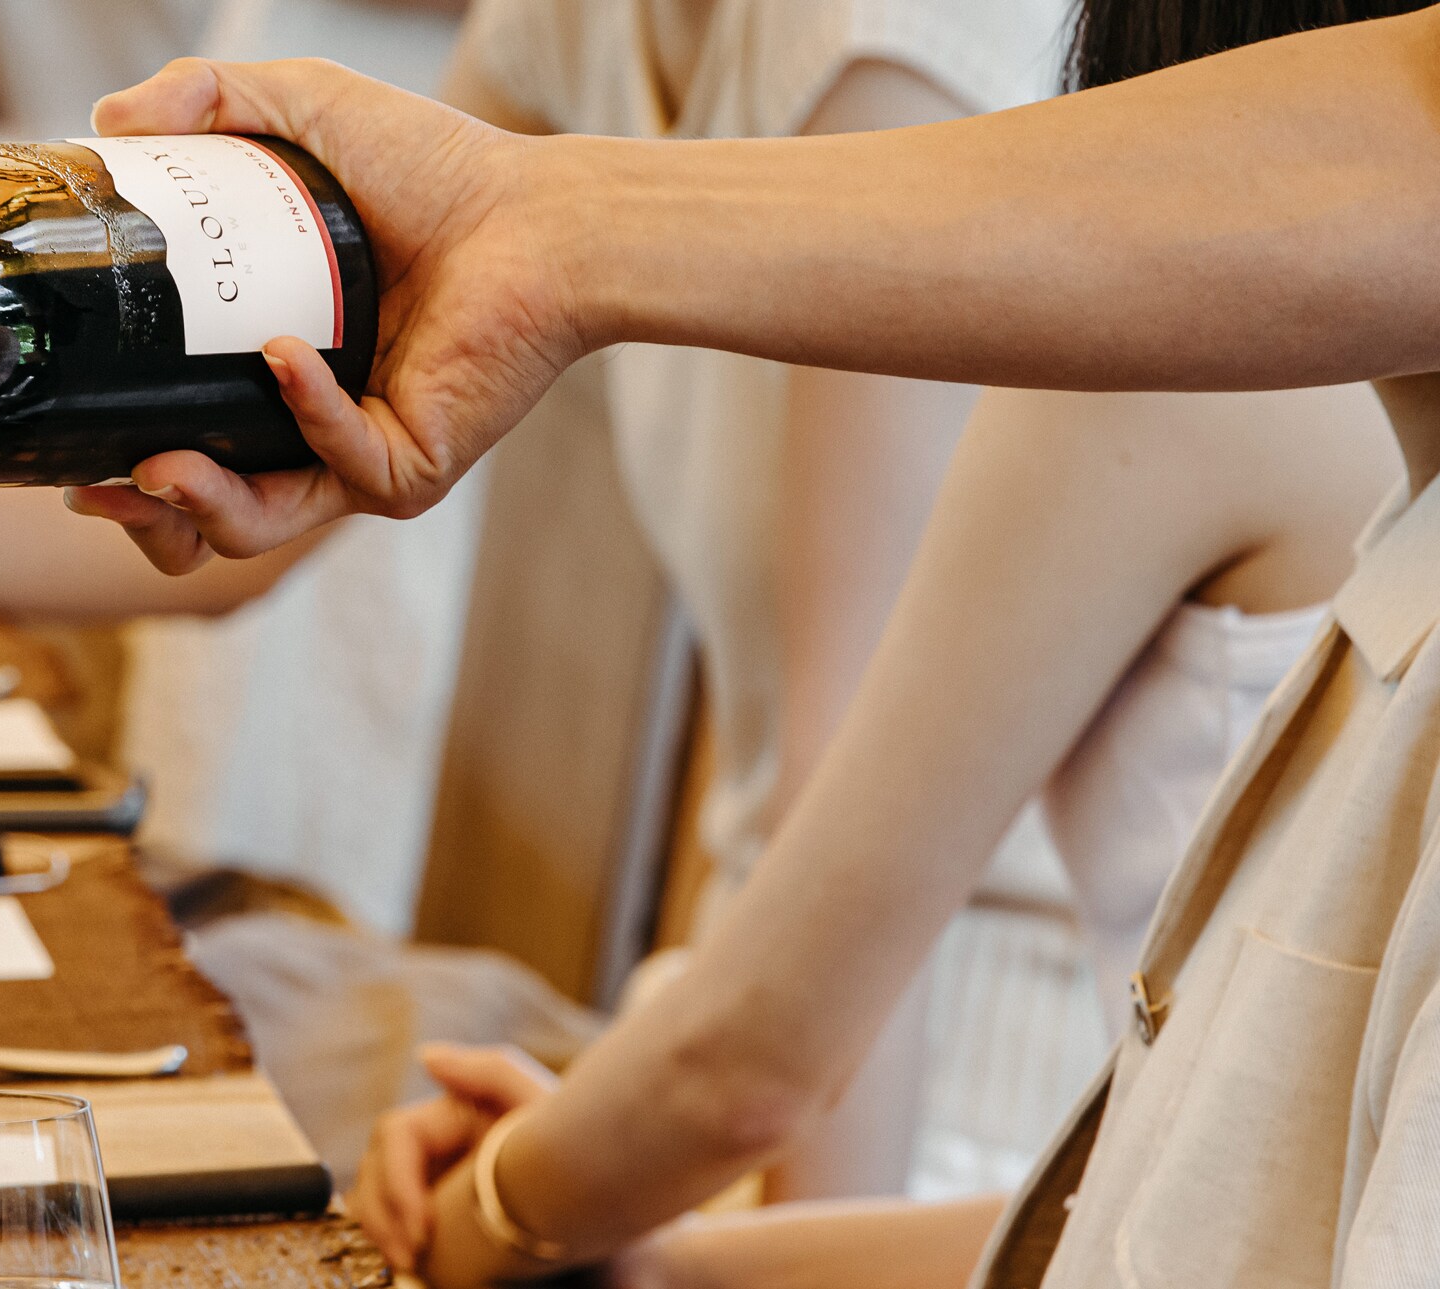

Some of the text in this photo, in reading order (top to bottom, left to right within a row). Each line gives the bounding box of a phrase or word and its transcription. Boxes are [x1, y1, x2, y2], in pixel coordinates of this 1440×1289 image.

[143, 151, 239, 303] CLOUDY
[245, 151, 308, 234] PINOT NOIR
[228, 216, 254, 275] NEW
